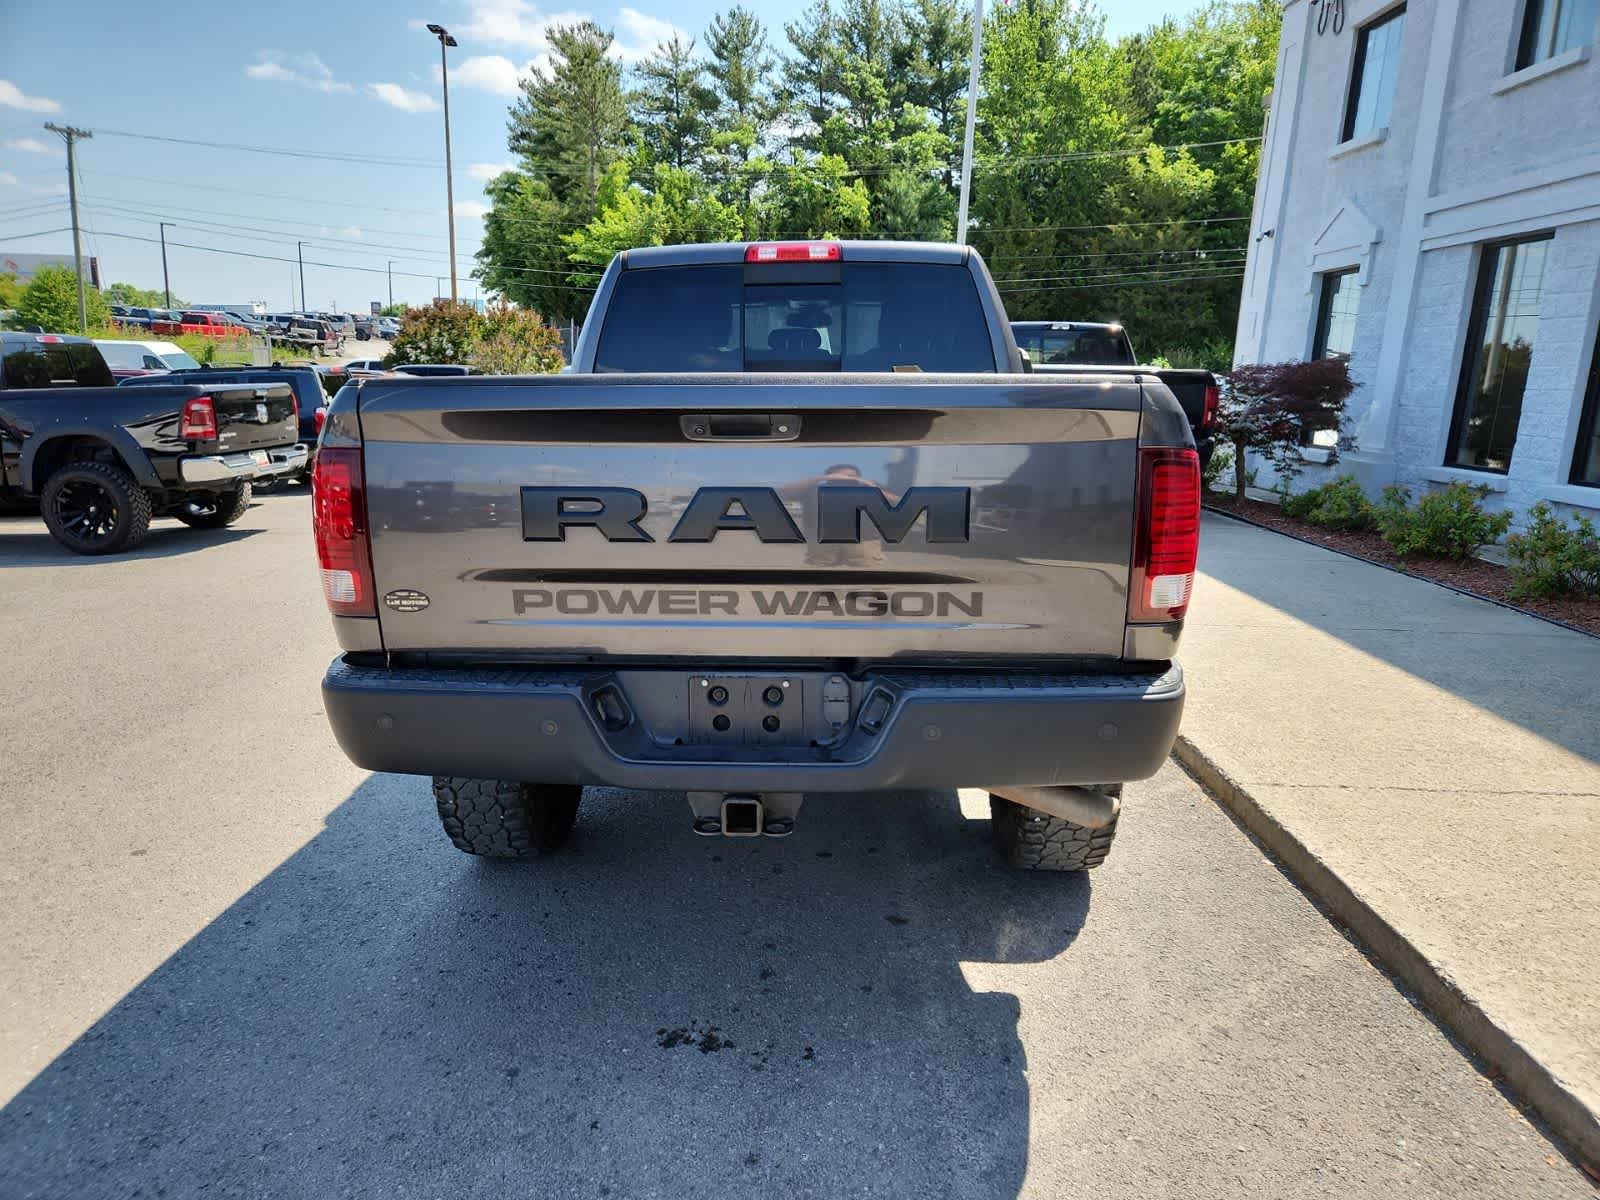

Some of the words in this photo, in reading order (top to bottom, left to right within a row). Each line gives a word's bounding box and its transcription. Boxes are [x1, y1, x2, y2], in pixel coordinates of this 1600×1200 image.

[520, 486, 971, 543] RAM
[512, 589, 740, 615] POWER
[751, 591, 983, 617] WAGON
